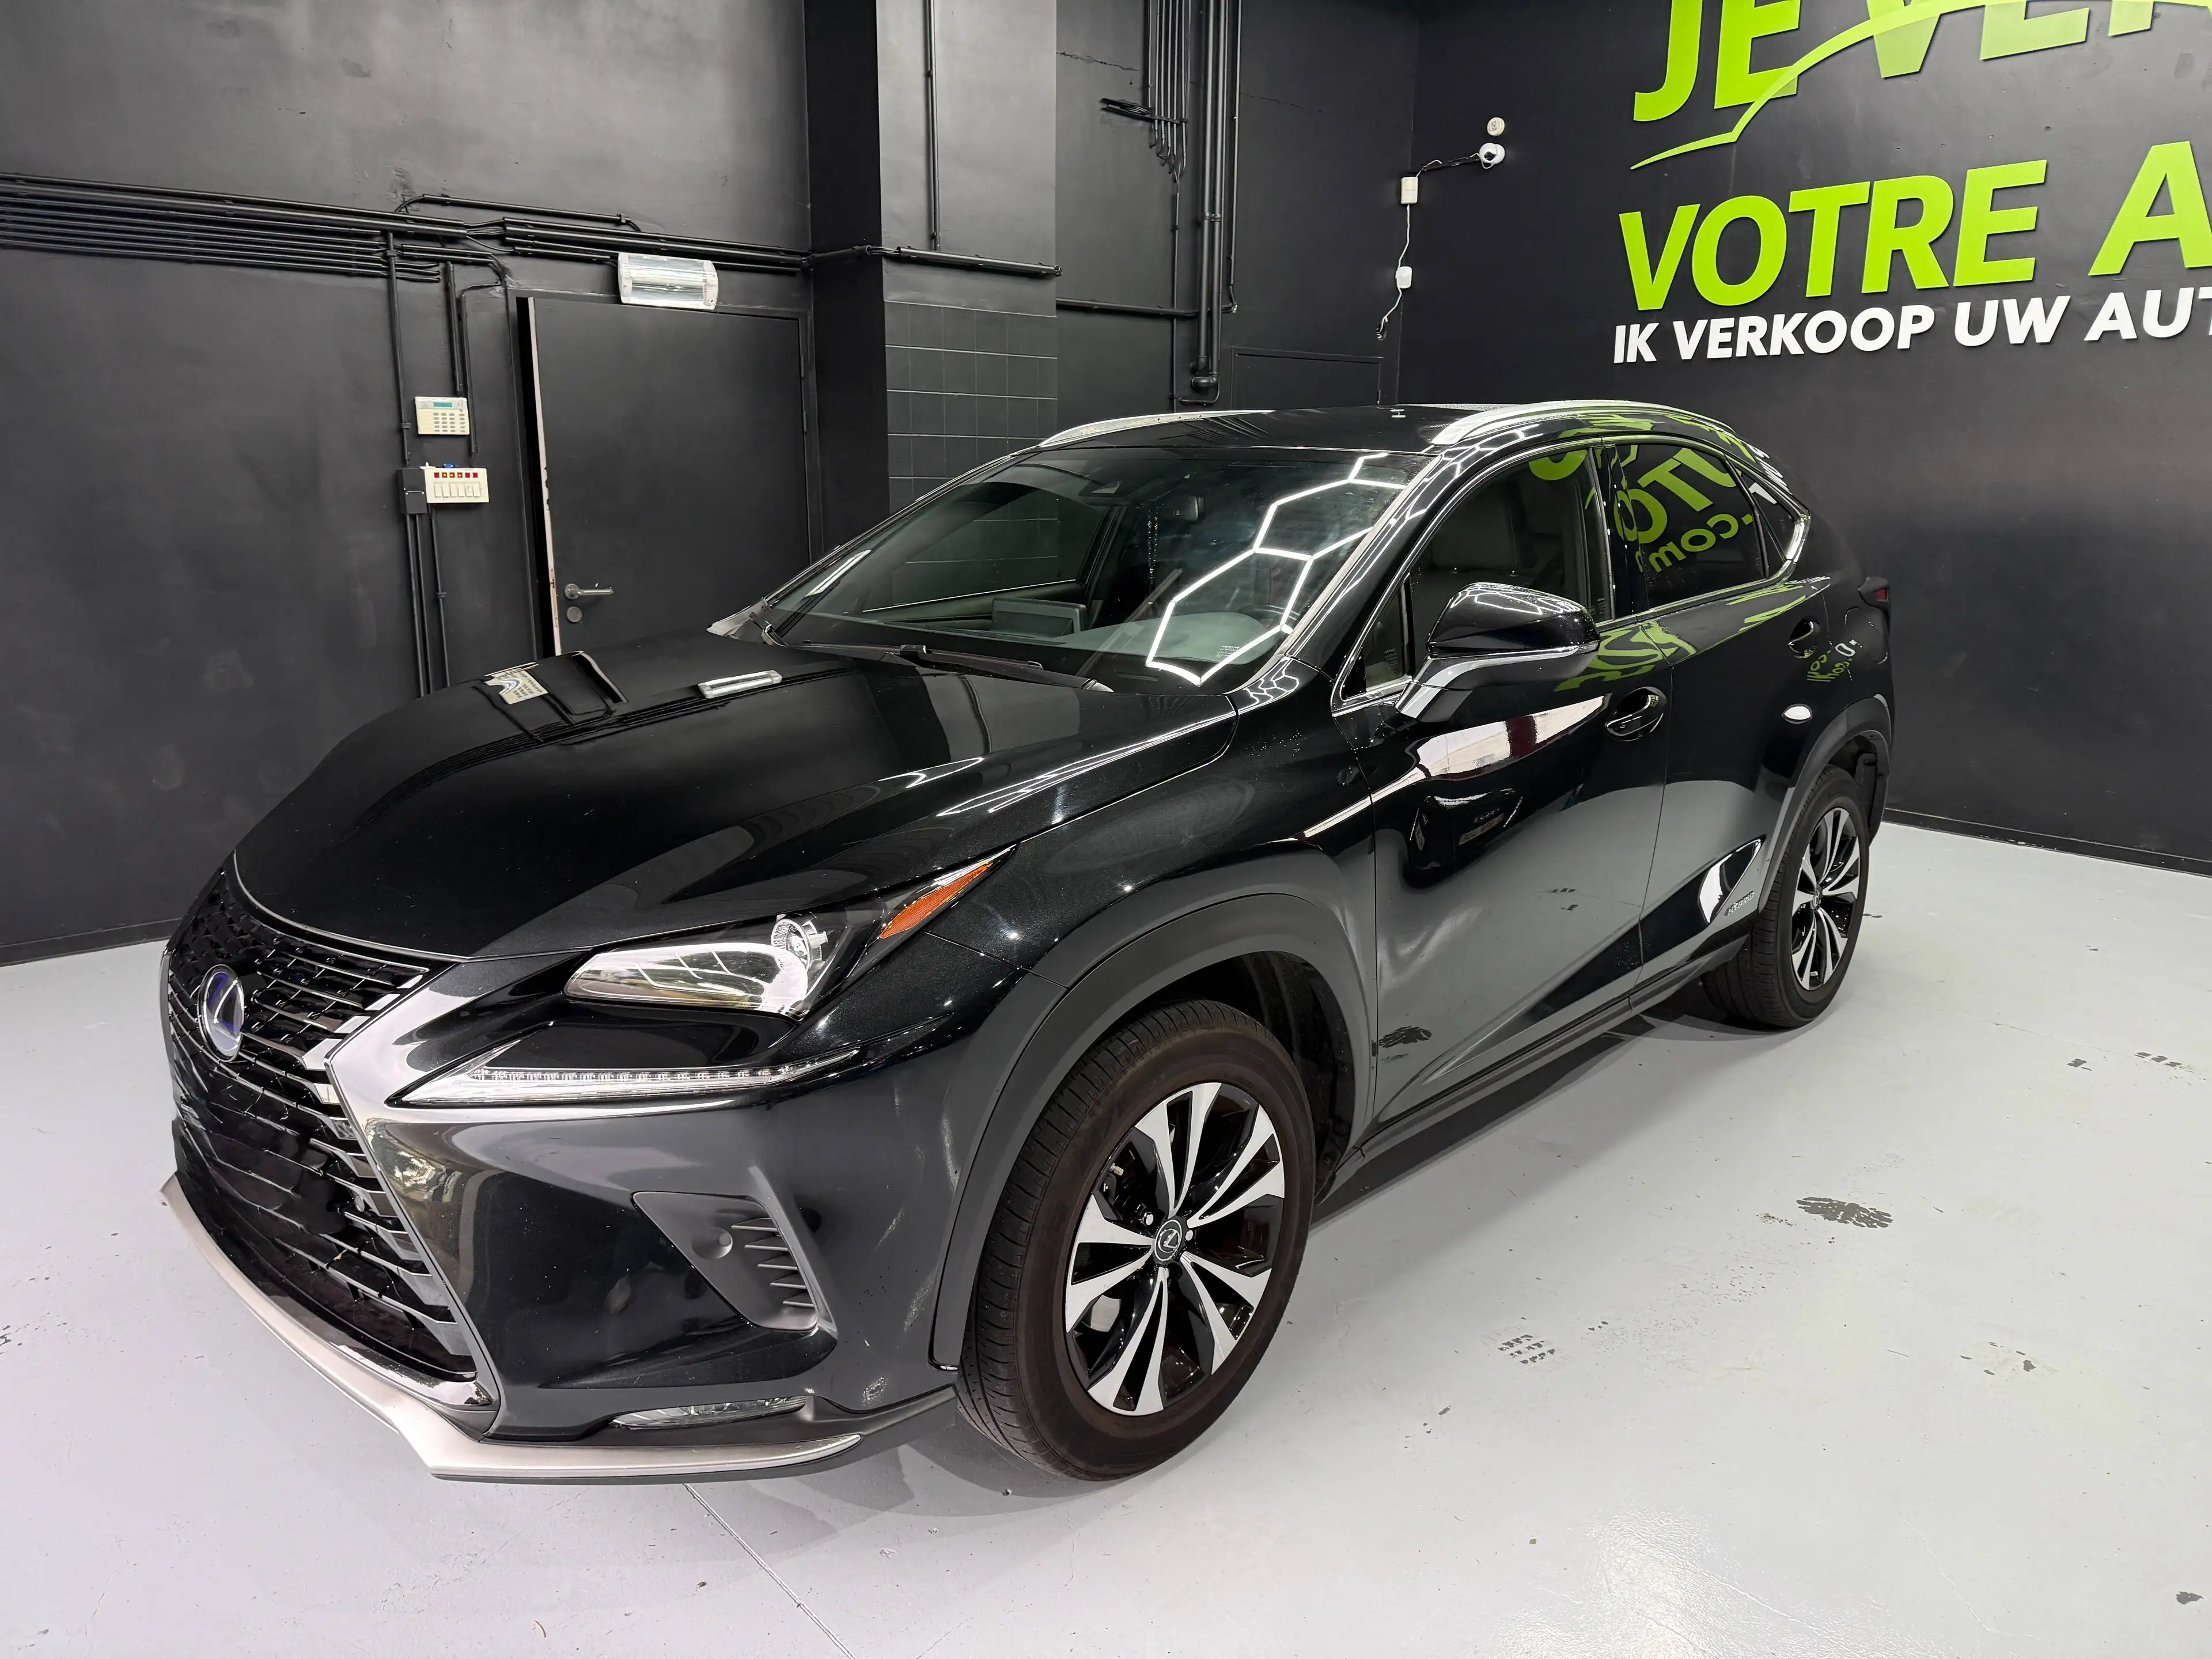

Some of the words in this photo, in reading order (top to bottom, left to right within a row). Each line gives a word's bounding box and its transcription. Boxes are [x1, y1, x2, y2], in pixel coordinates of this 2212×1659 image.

[1619, 160, 2048, 311] VOTRE
[1613, 323, 1660, 363] IK
[1672, 304, 1935, 360] VERKOOP
[1954, 295, 2071, 347] UW
[1725, 891, 1755, 916] HYBRID
